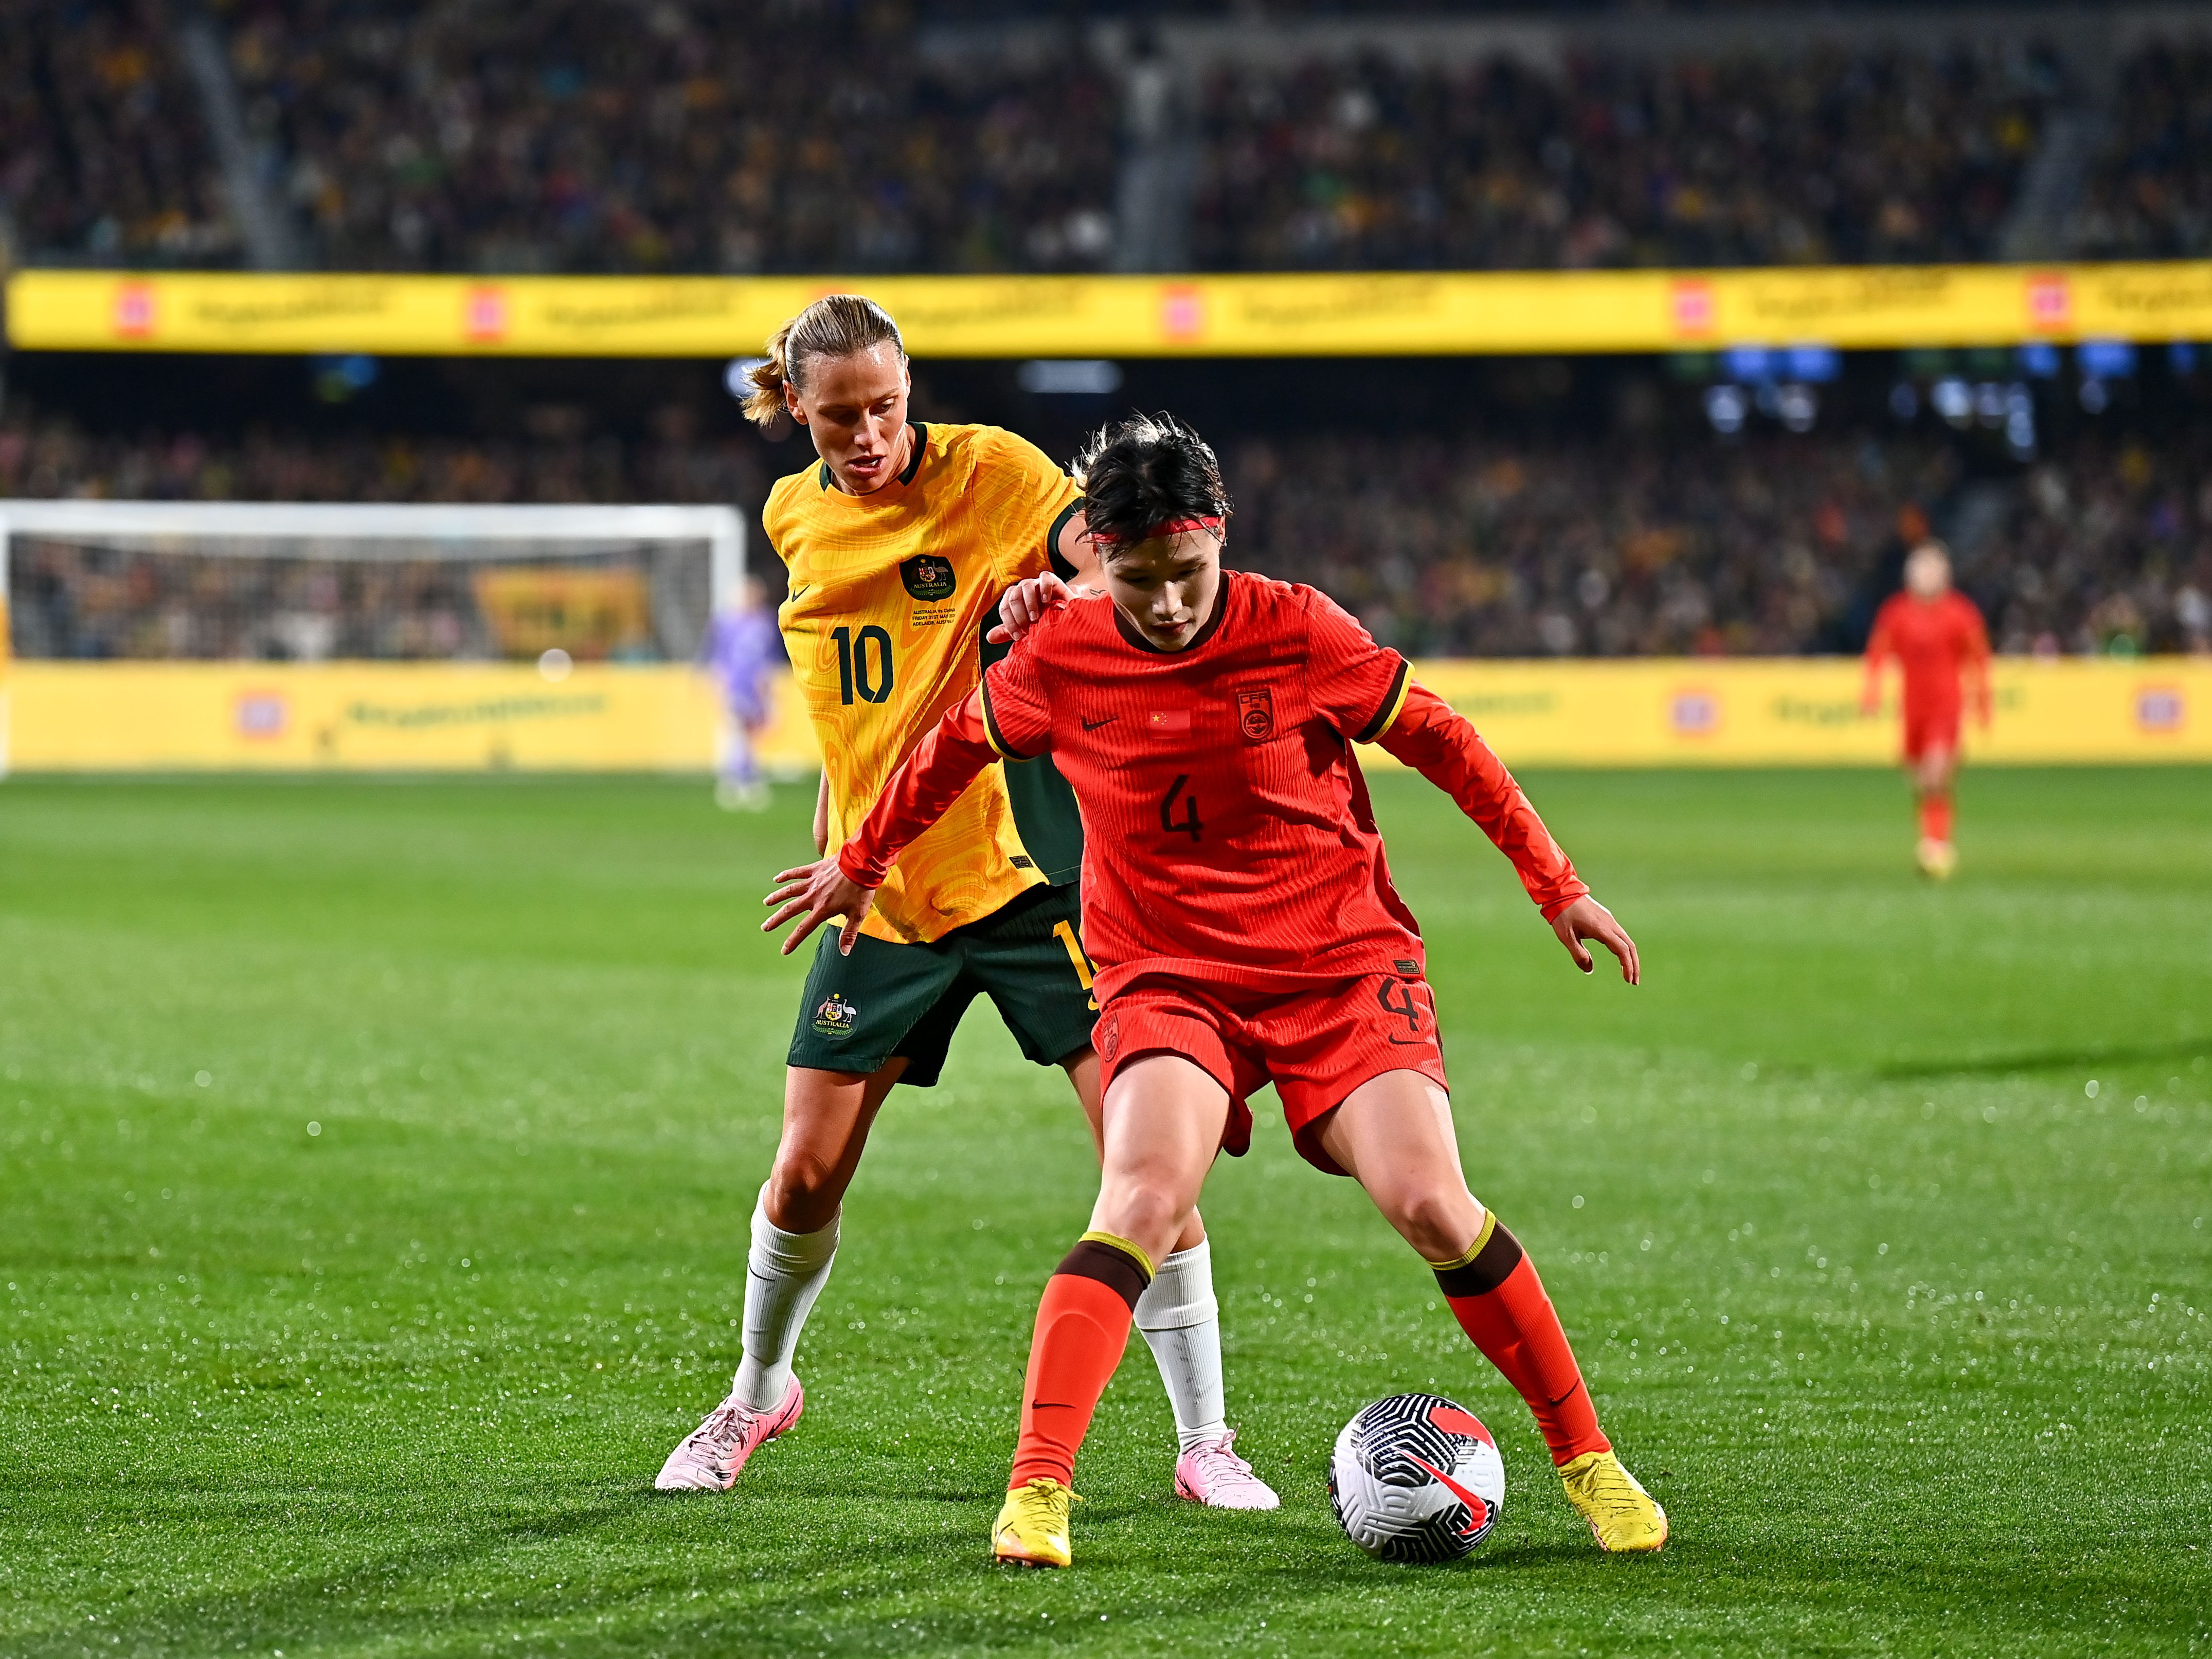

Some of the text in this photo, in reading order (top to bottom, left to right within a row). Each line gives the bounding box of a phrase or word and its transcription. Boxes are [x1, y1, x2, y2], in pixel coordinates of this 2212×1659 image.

[831, 625, 893, 705] 10
[1239, 693, 1269, 704] CFA
[1160, 775, 1203, 842] 4
[1053, 920, 1100, 990] 1
[816, 1020, 849, 1029] AUSTRALIA
[1377, 977, 1419, 1032] 4
